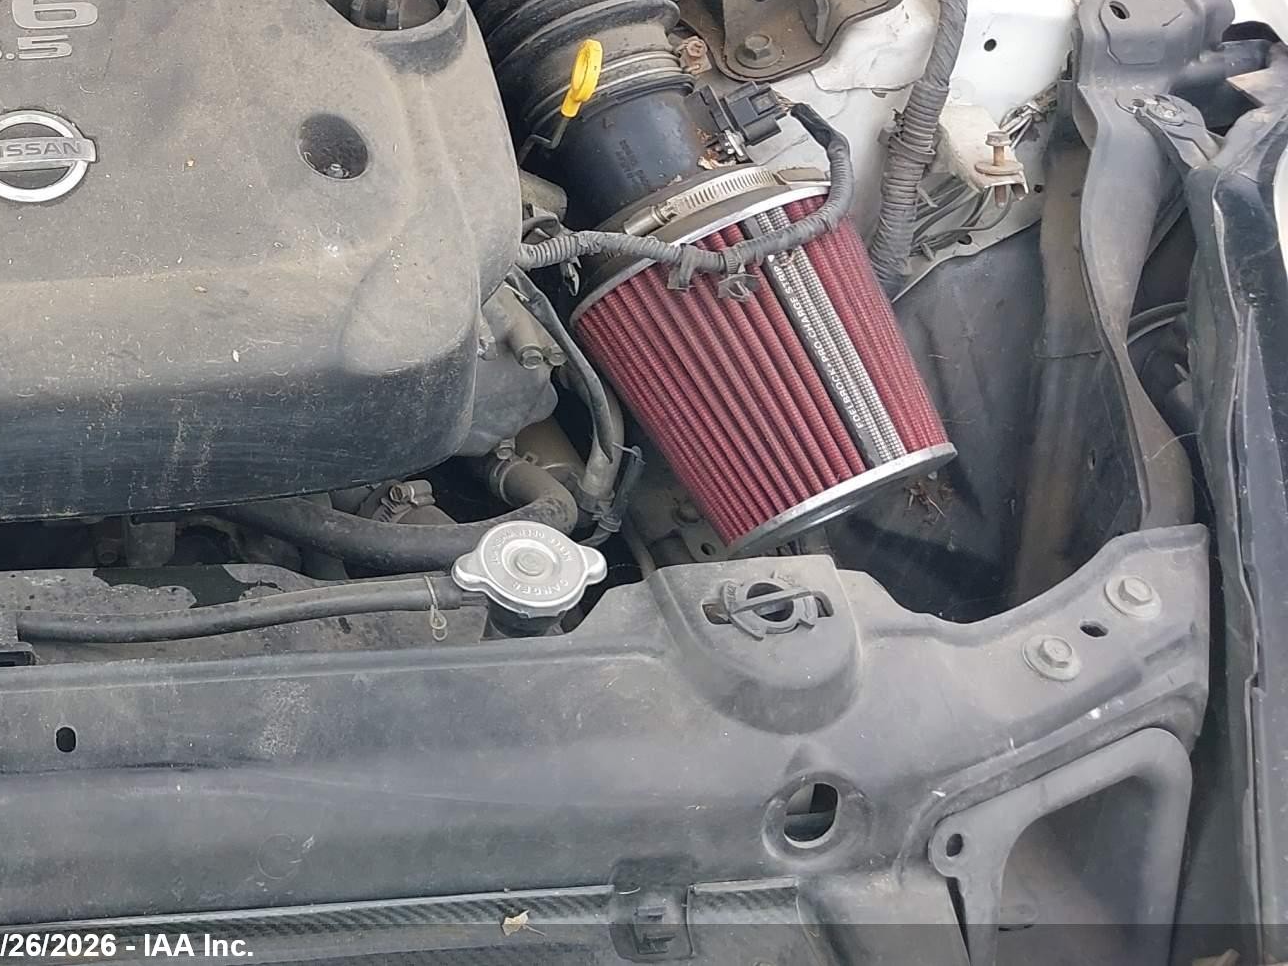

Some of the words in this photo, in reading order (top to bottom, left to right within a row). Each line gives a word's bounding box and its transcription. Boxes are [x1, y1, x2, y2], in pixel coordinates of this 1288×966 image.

[773, 265, 794, 294] STRIP
[790, 297, 817, 338] CHARGE
[813, 341, 830, 363] PRO
